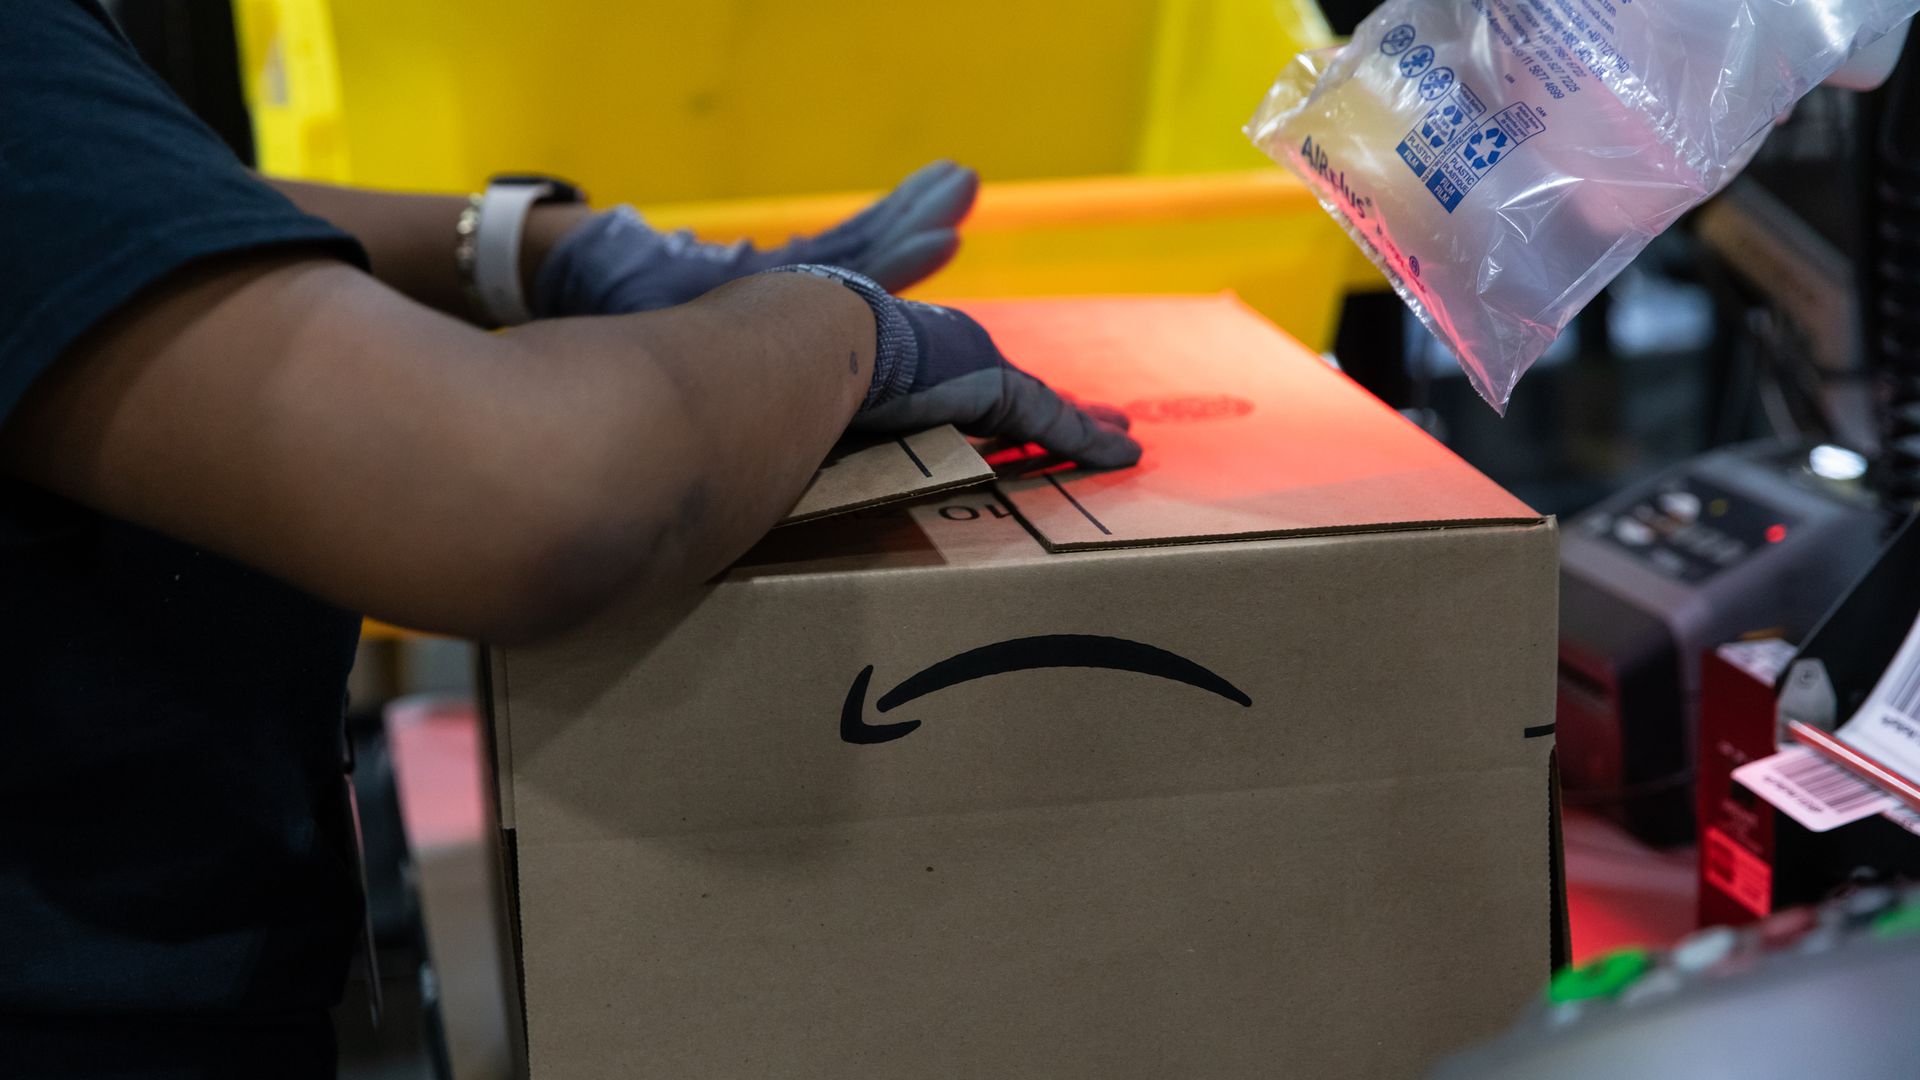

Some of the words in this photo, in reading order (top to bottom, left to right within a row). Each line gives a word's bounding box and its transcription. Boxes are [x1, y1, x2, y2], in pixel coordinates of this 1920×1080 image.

[1529, 64, 1550, 81] 5677
[1544, 82, 1565, 99] 4699
[1403, 149, 1420, 169] FILM
[1407, 135, 1432, 164] PLASTIC
[1442, 162, 1470, 194] PLASTIQUE
[1450, 156, 1476, 186] PLASTIC
[1433, 184, 1450, 204] FILM
[1440, 176, 1457, 196] FILM
